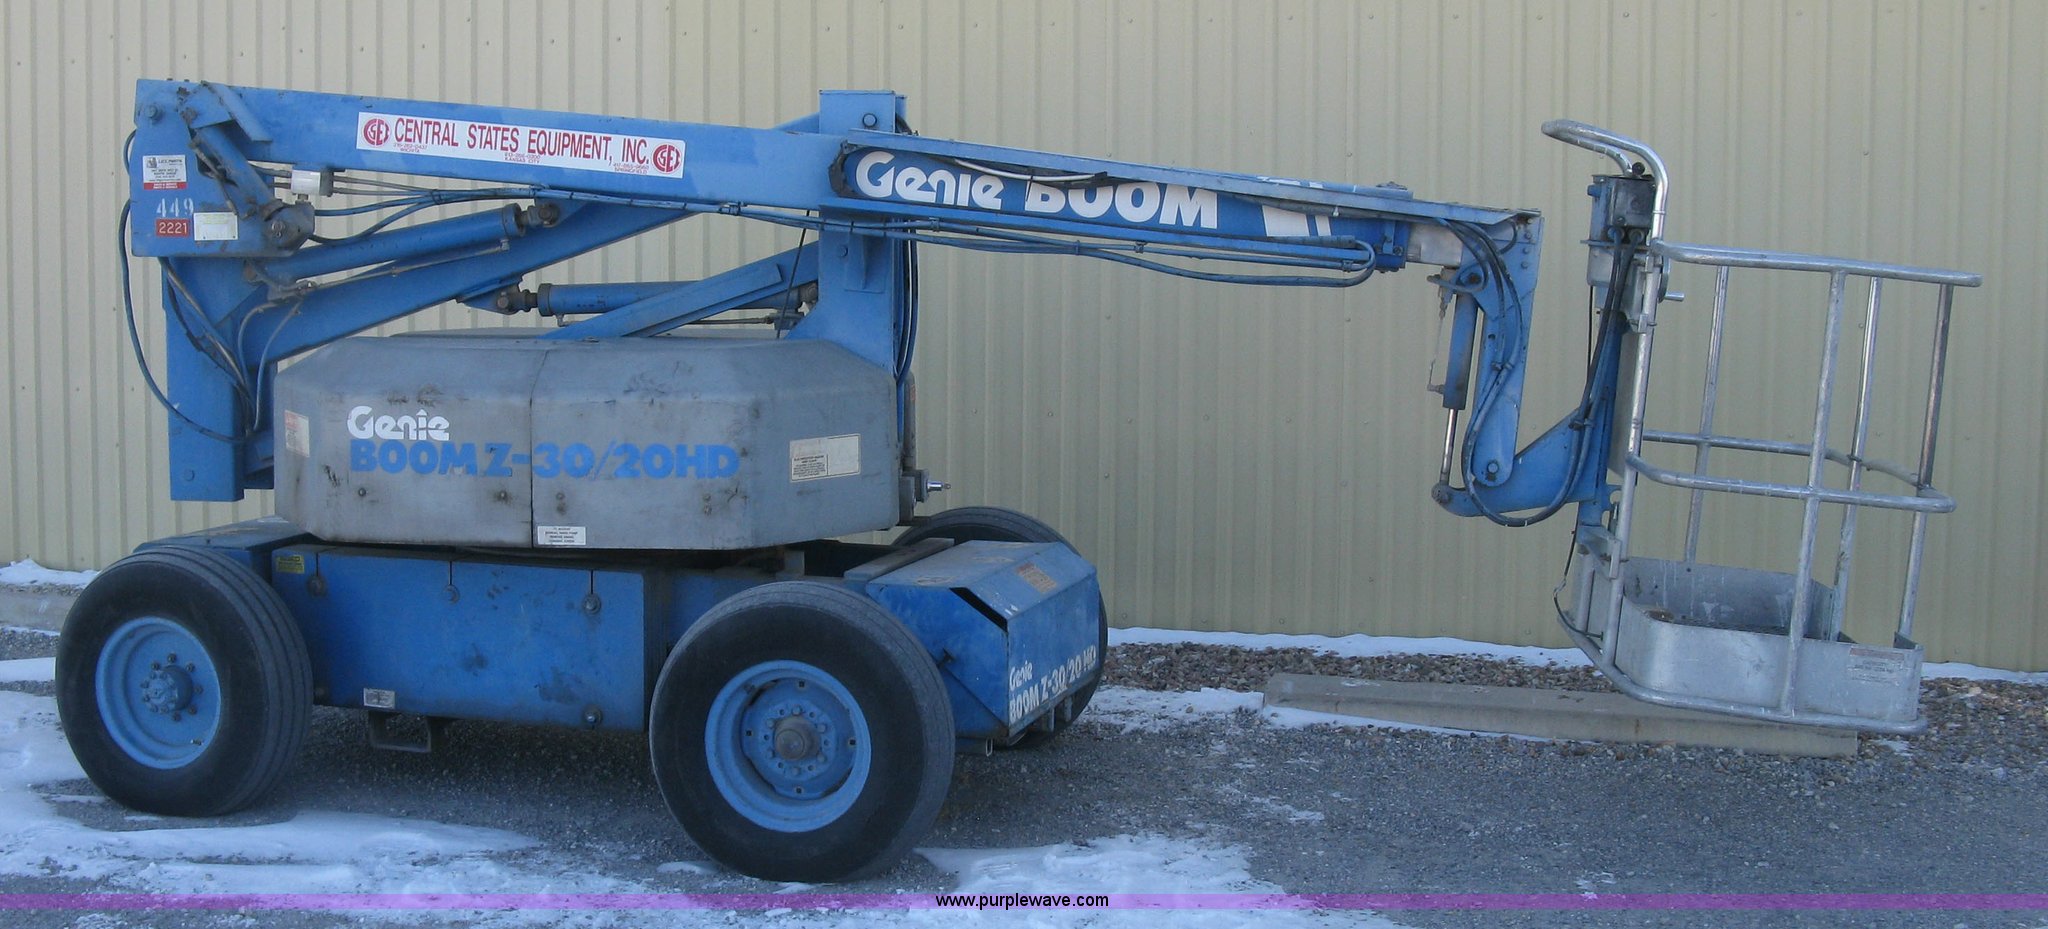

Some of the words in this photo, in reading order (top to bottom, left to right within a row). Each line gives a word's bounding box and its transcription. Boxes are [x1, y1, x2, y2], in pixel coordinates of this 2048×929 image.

[395, 117, 459, 147] CENTRAL
[467, 124, 519, 153] STATES
[527, 129, 612, 167] EQUIPMENT,
[622, 138, 649, 165] INC.
[156, 198, 194, 218] 449
[856, 151, 1004, 210] Genie
[1024, 180, 1217, 229] BOOM
[159, 222, 187, 234] 2221
[347, 405, 450, 441] Genie
[351, 439, 478, 476] BOOM
[1009, 660, 1033, 692] Genie
[1009, 683, 1040, 723] BOOM
